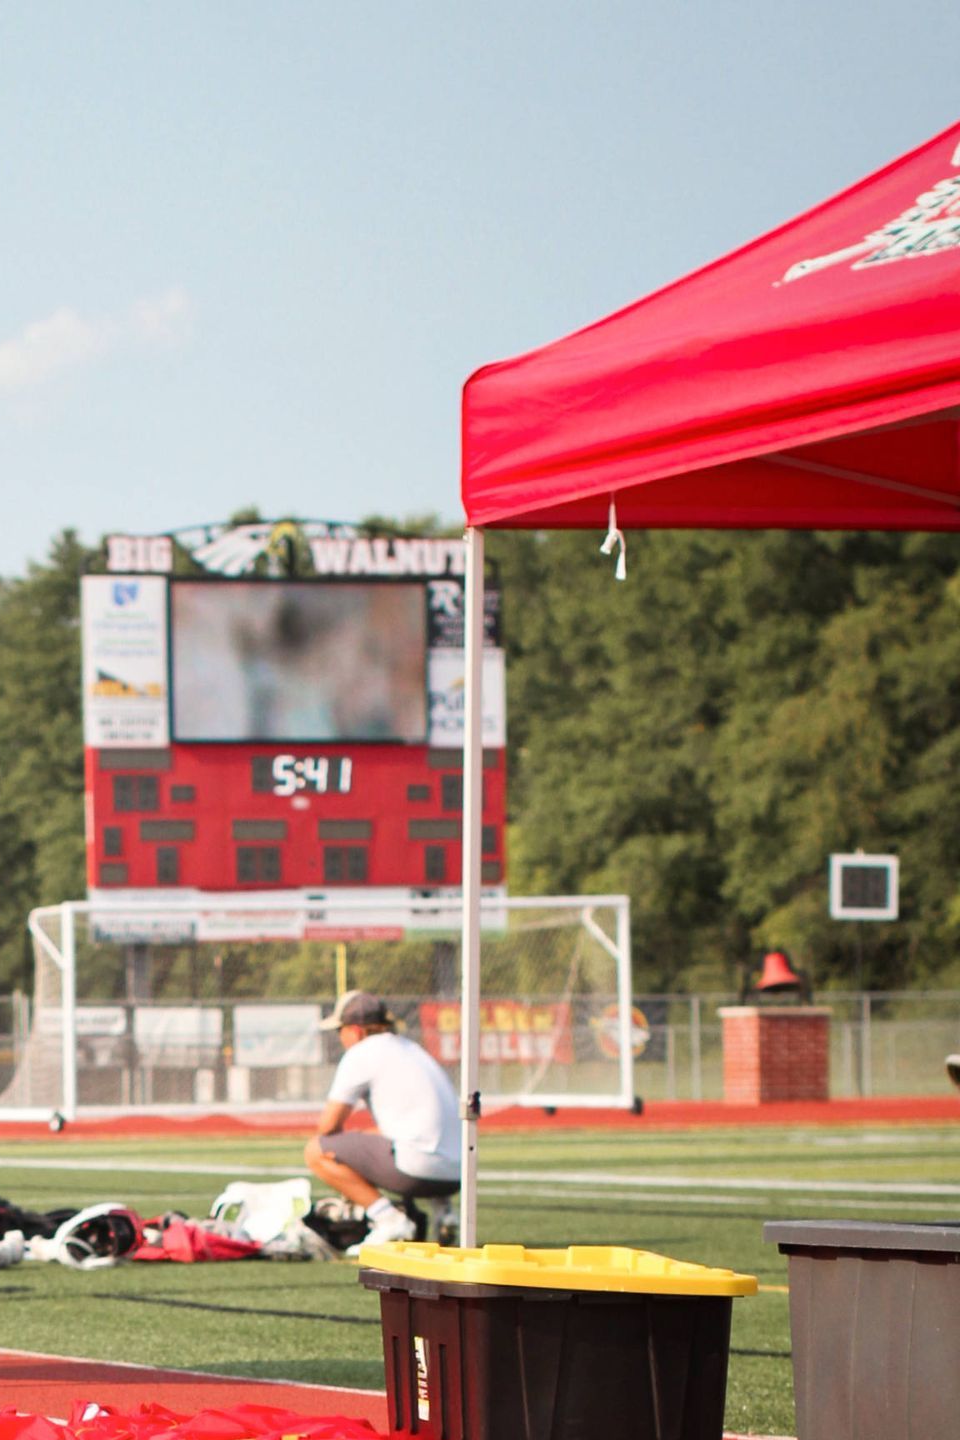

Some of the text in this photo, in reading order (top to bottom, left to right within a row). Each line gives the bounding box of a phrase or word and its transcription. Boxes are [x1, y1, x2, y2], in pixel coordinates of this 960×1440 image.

[107, 535, 467, 575] BIG WALNUT
[272, 754, 352, 796] 5:41
